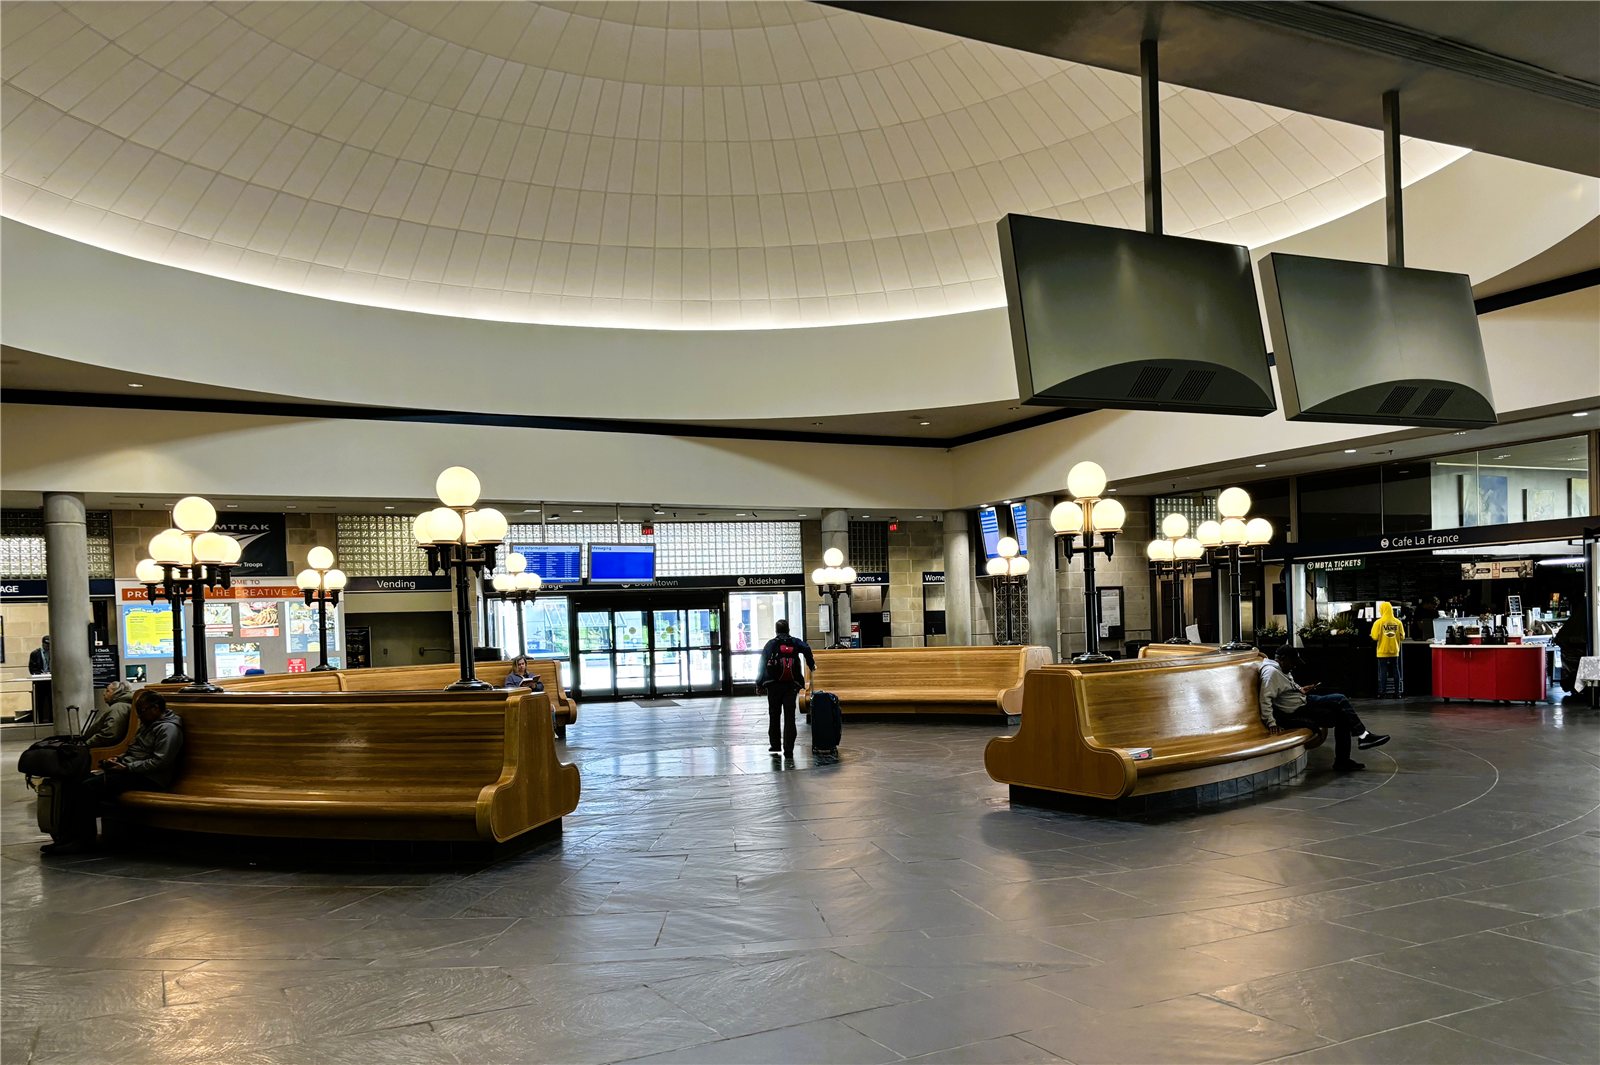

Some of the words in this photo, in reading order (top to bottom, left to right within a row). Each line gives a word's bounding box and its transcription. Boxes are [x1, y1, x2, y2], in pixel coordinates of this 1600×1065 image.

[1392, 536, 1413, 547] Cafe
[1414, 536, 1425, 545] La
[1427, 534, 1459, 544] France
[1314, 561, 1333, 569] MBTA
[1334, 559, 1362, 568] TICKETS
[749, 577, 786, 585] Rideshare
[924, 574, 945, 582] Wome
[376, 580, 416, 589] Vending
[235, 588, 288, 597] CREATIVE
